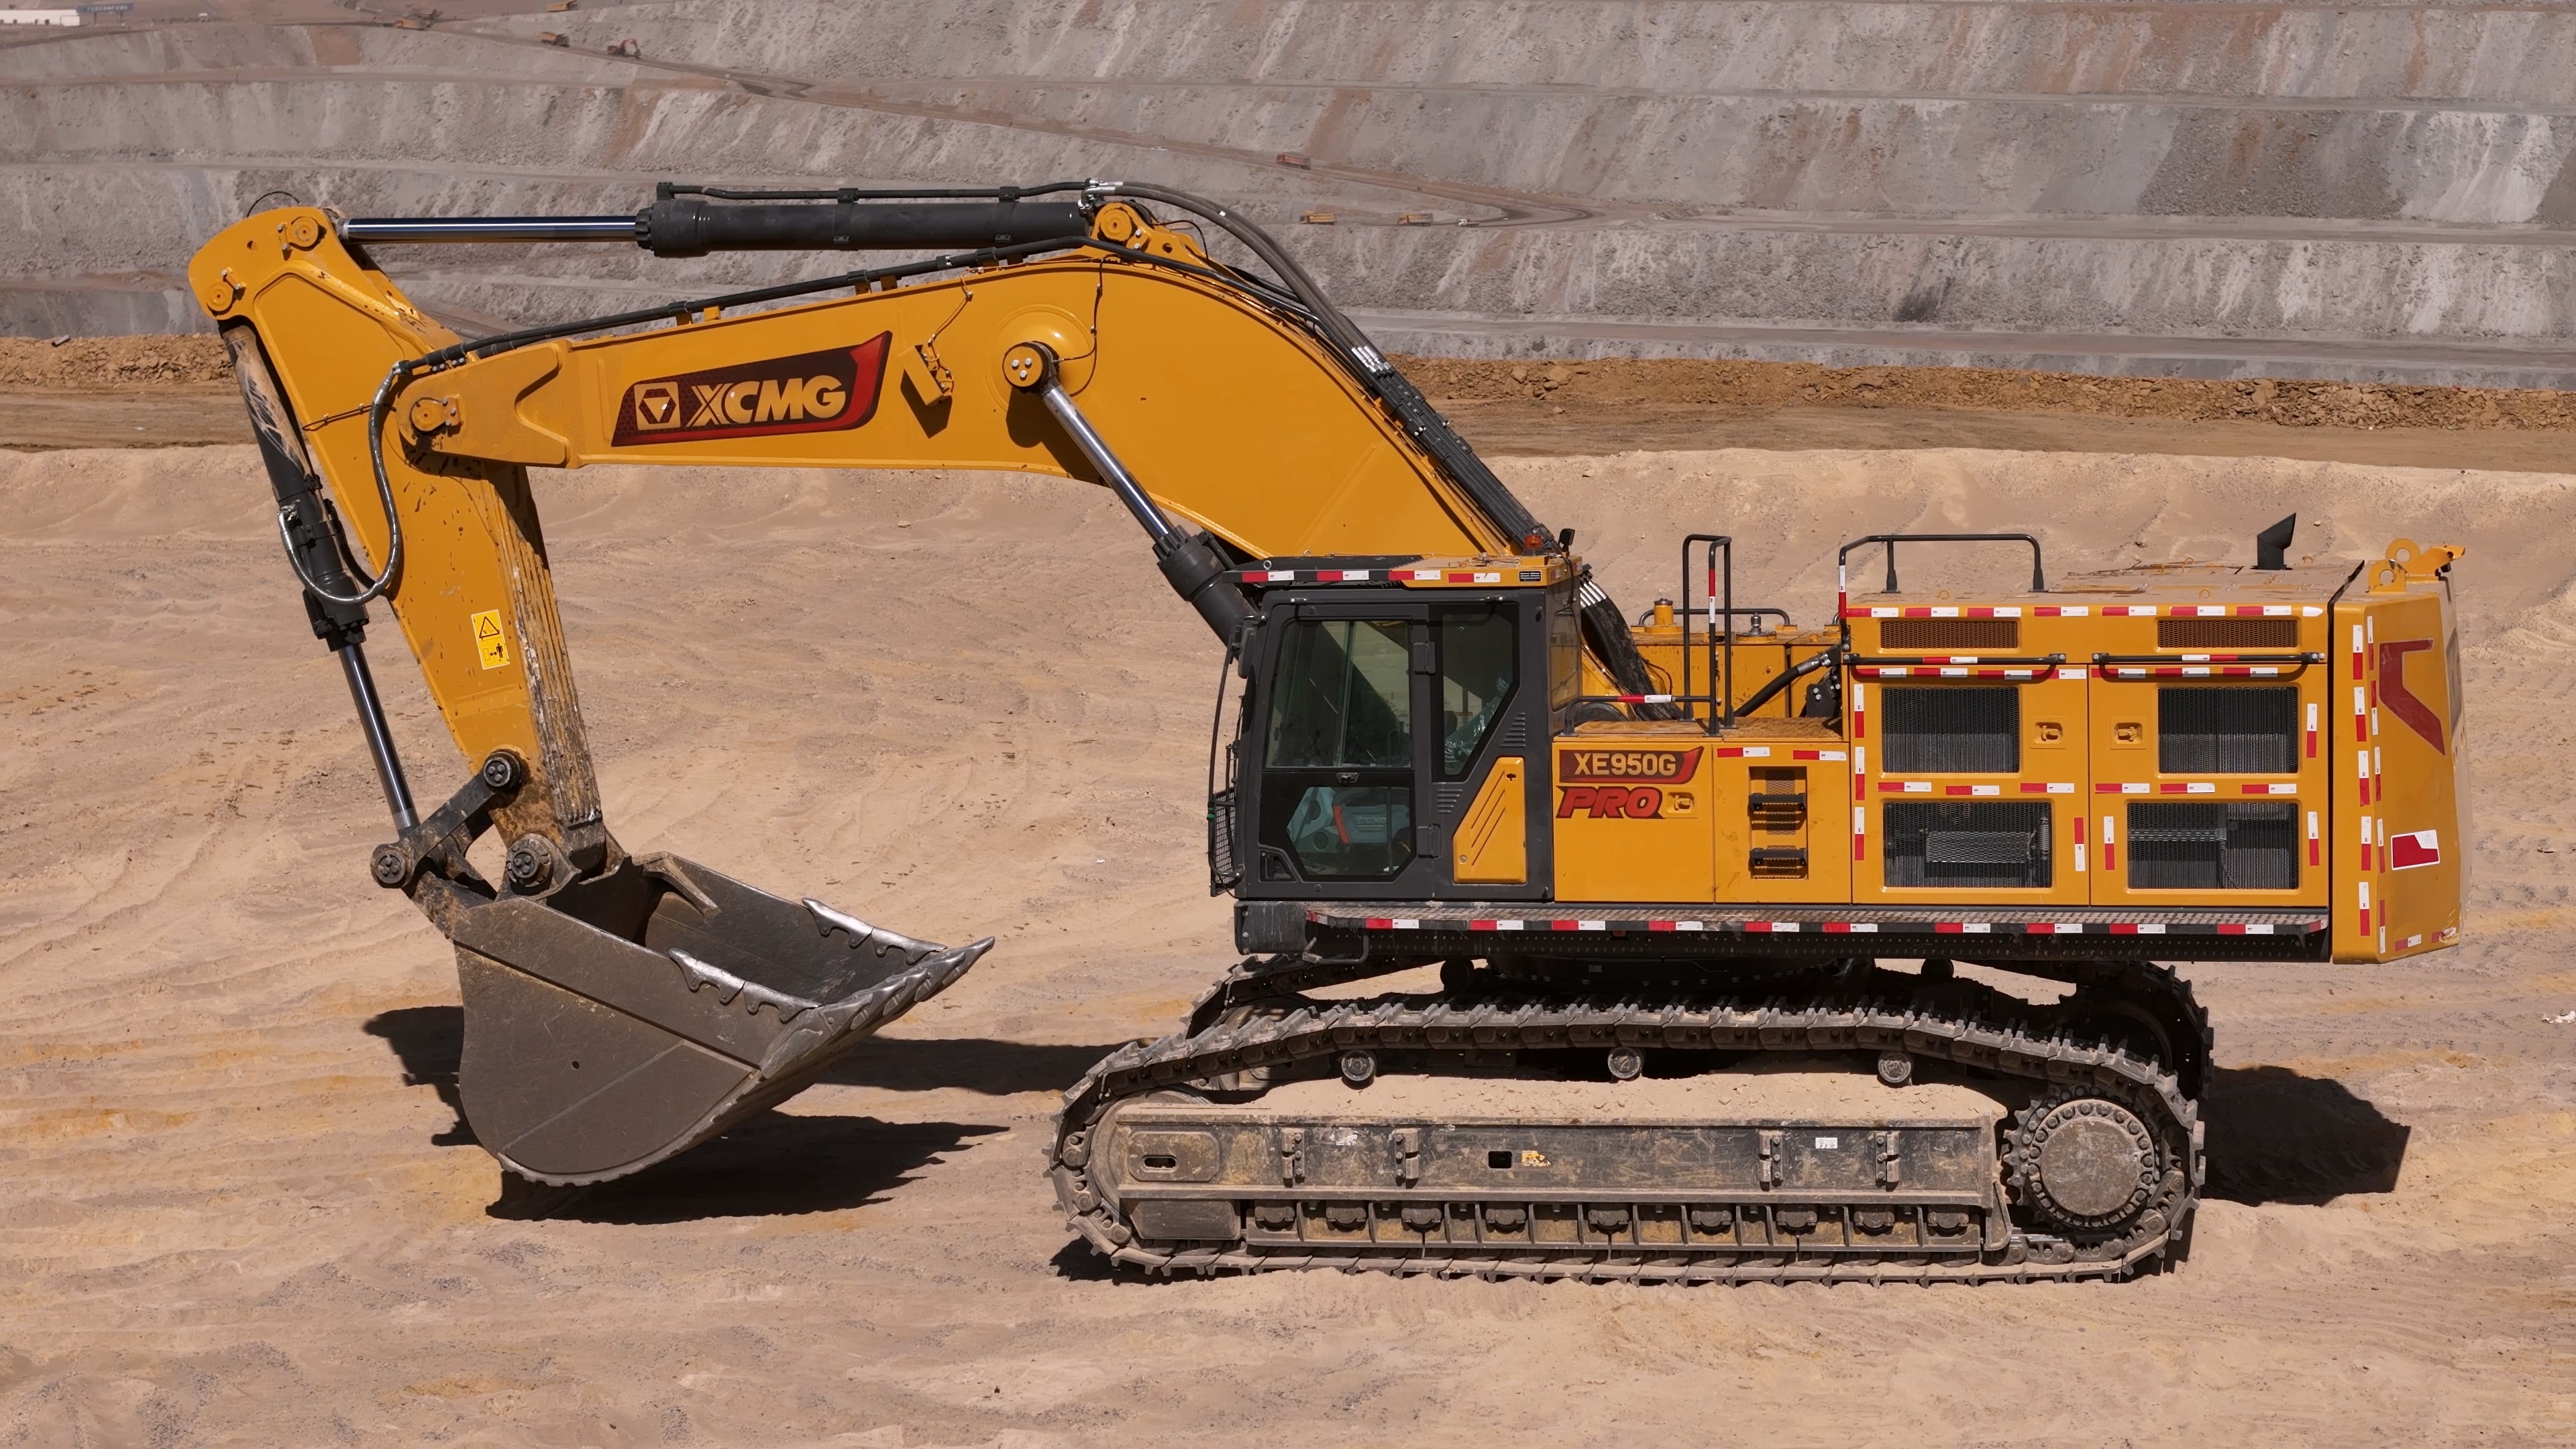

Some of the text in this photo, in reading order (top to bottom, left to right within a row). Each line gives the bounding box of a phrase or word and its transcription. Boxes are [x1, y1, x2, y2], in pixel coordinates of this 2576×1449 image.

[686, 374, 846, 427] XCMG
[1574, 753, 1676, 776] XE950G
[1556, 786, 1664, 818] PRO
